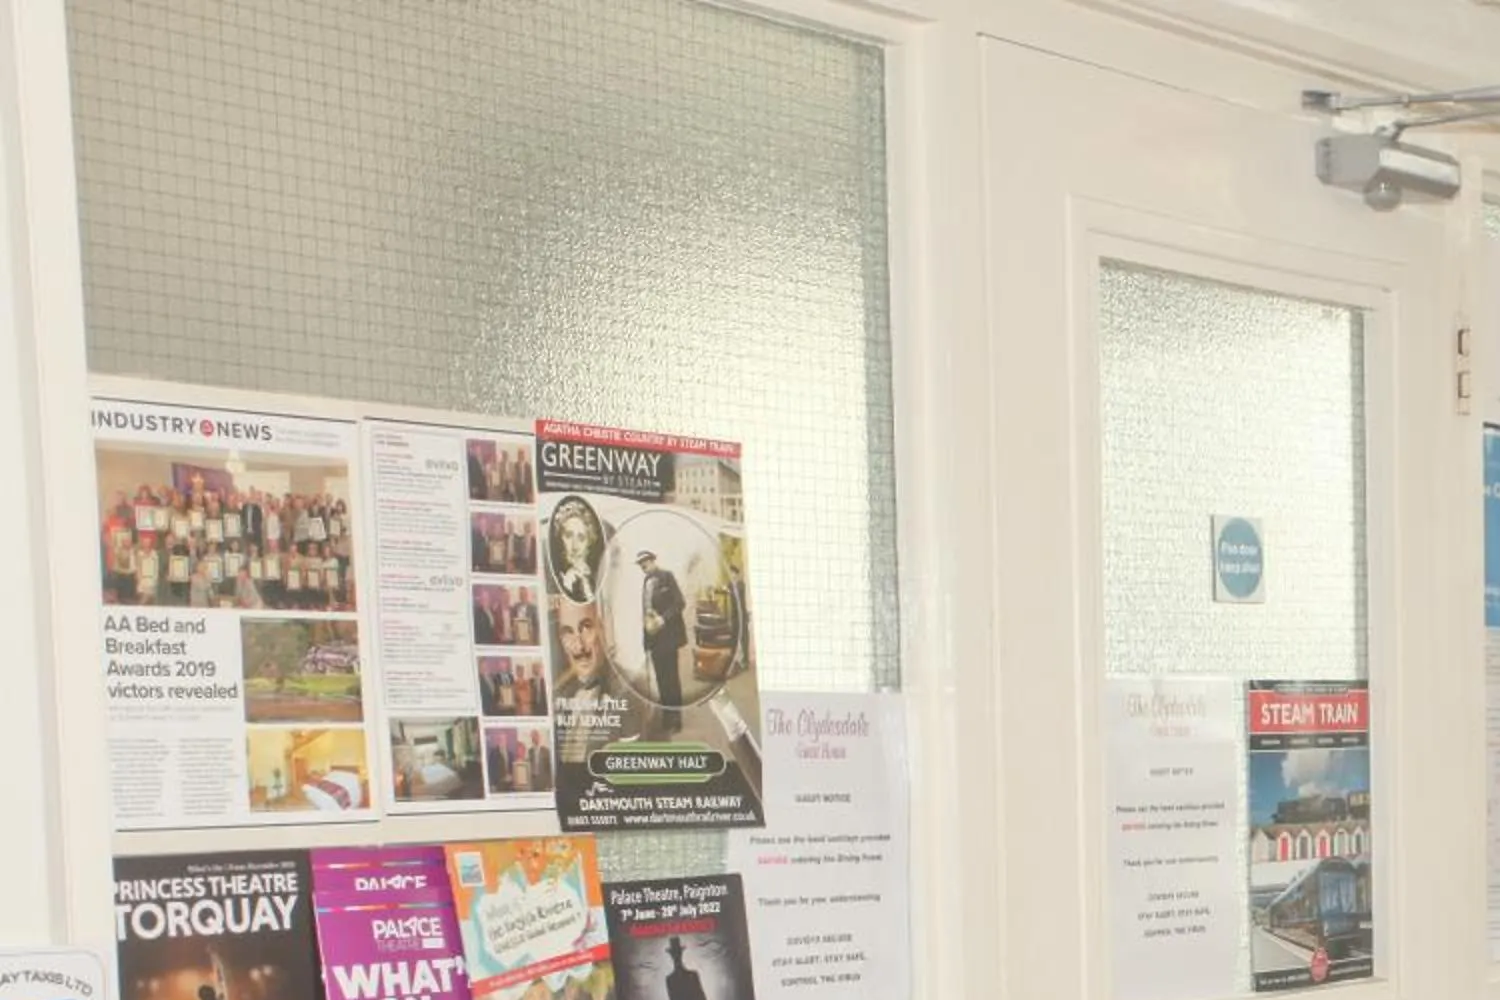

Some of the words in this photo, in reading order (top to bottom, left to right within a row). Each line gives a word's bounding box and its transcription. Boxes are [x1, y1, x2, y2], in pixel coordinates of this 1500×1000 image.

[91, 410, 195, 434] INDUSTRY
[217, 421, 273, 441] NEWS
[681, 437, 706, 449] STEAM
[541, 442, 661, 477] GREENWAY
[104, 615, 130, 633] AA
[136, 616, 169, 633] Bed
[174, 617, 205, 633] and
[105, 637, 186, 656] Breakfast
[107, 660, 171, 677] Awards
[175, 660, 215, 677] 2019
[108, 682, 163, 700] victors
[168, 682, 237, 700] revealed
[1261, 702, 1315, 725] STEAM
[1319, 703, 1358, 724] TRAIN
[606, 755, 674, 770] GREENWAY
[678, 755, 708, 769] HALT
[579, 797, 653, 812] DARTMOUTH
[655, 796, 692, 809] STEAM
[696, 796, 743, 809] RAILWAY
[112, 876, 205, 902] PRINCESS
[208, 872, 299, 895] THEATRE
[611, 889, 641, 905] Palace
[642, 886, 683, 904] Theatre,
[683, 883, 728, 900] Paignton
[116, 895, 298, 941] TORQUAY
[679, 904, 698, 918] July
[372, 916, 443, 940] PALACE
[24, 970, 63, 986] TAXIS
[65, 975, 93, 998] LTD
[331, 954, 465, 1000] WHAT'
